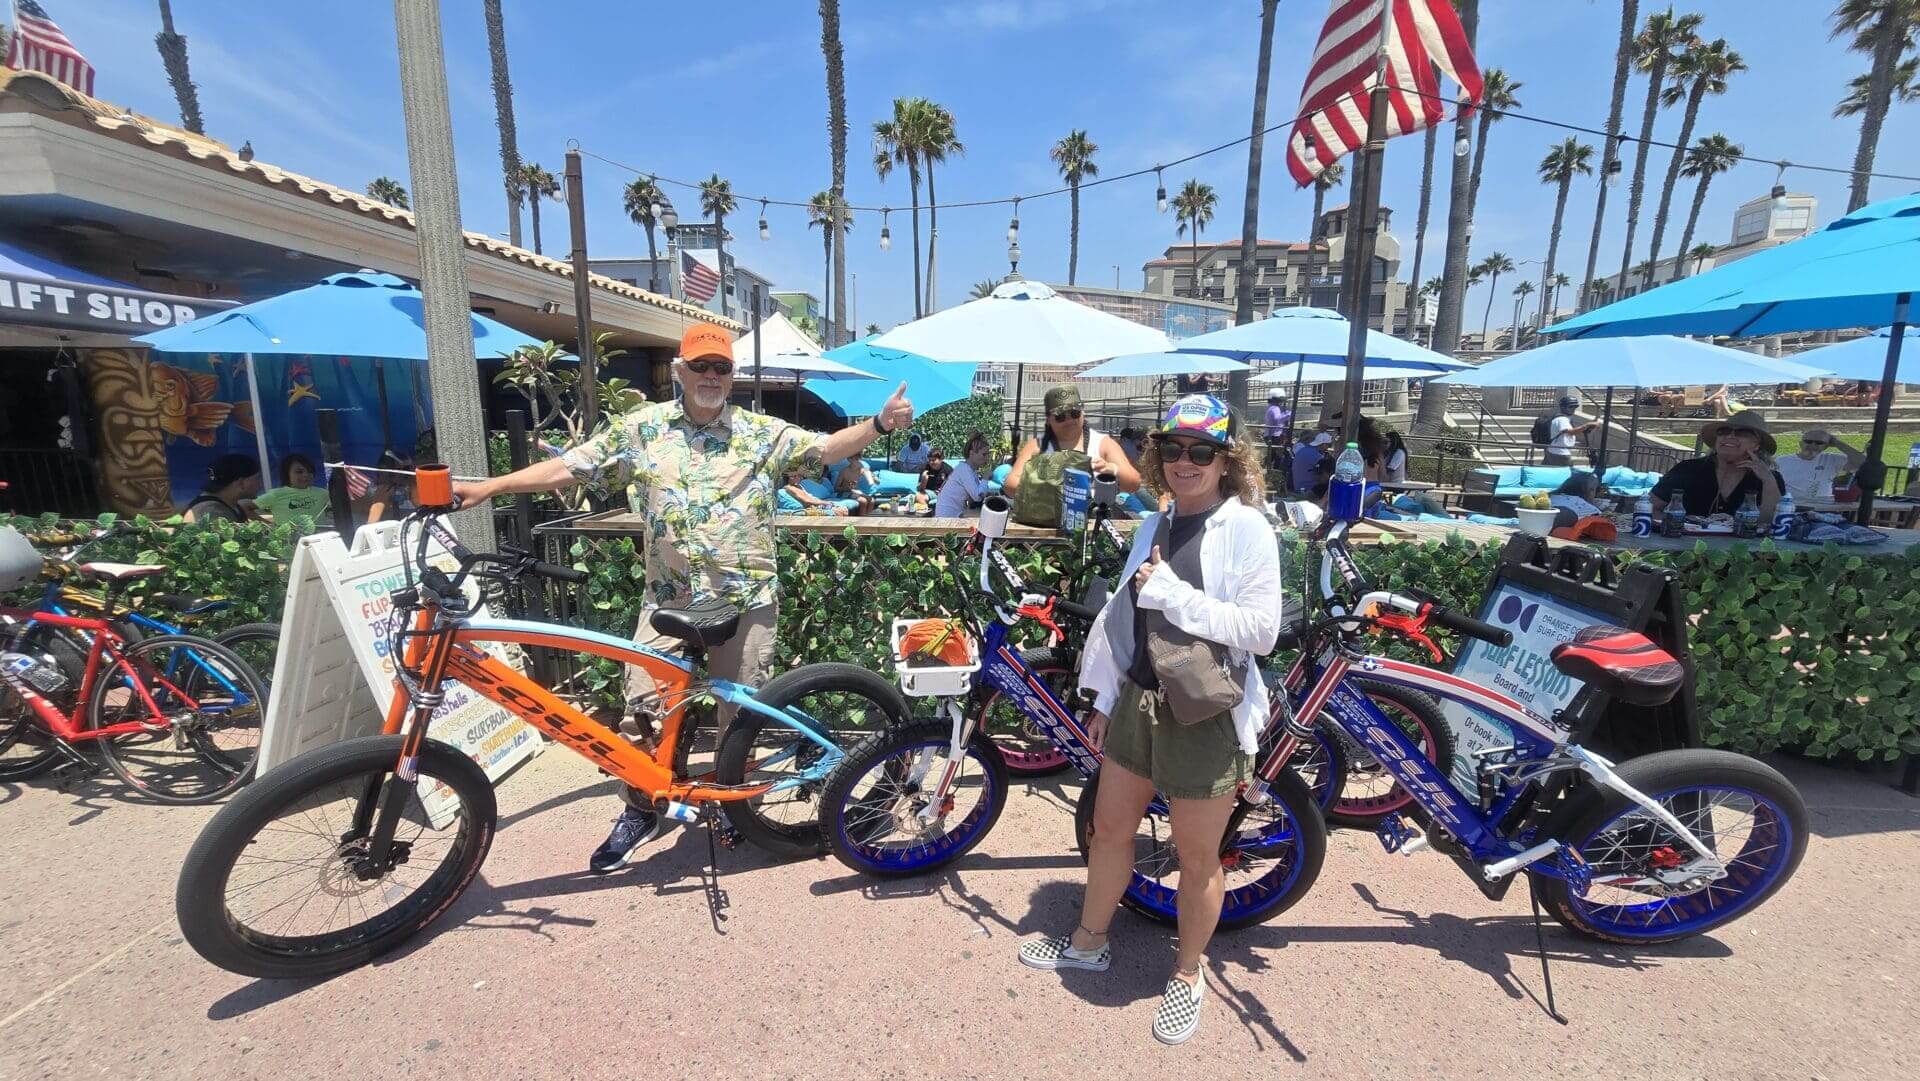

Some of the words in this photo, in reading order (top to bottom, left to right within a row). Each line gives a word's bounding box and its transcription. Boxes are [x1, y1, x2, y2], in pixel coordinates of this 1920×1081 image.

[0, 279, 75, 314] IFT
[87, 293, 196, 326] SHOP
[368, 612, 412, 639] BEAC
[1537, 625, 1555, 638] SURF
[1542, 614, 1569, 632] ORANGE
[1493, 673, 1518, 693] Board
[1517, 685, 1536, 704] and
[449, 655, 628, 770] SOUL
[1464, 716, 1475, 730] Or
[1473, 720, 1492, 742] book
[1466, 738, 1475, 749] at
[1331, 691, 1463, 824] SOUL
